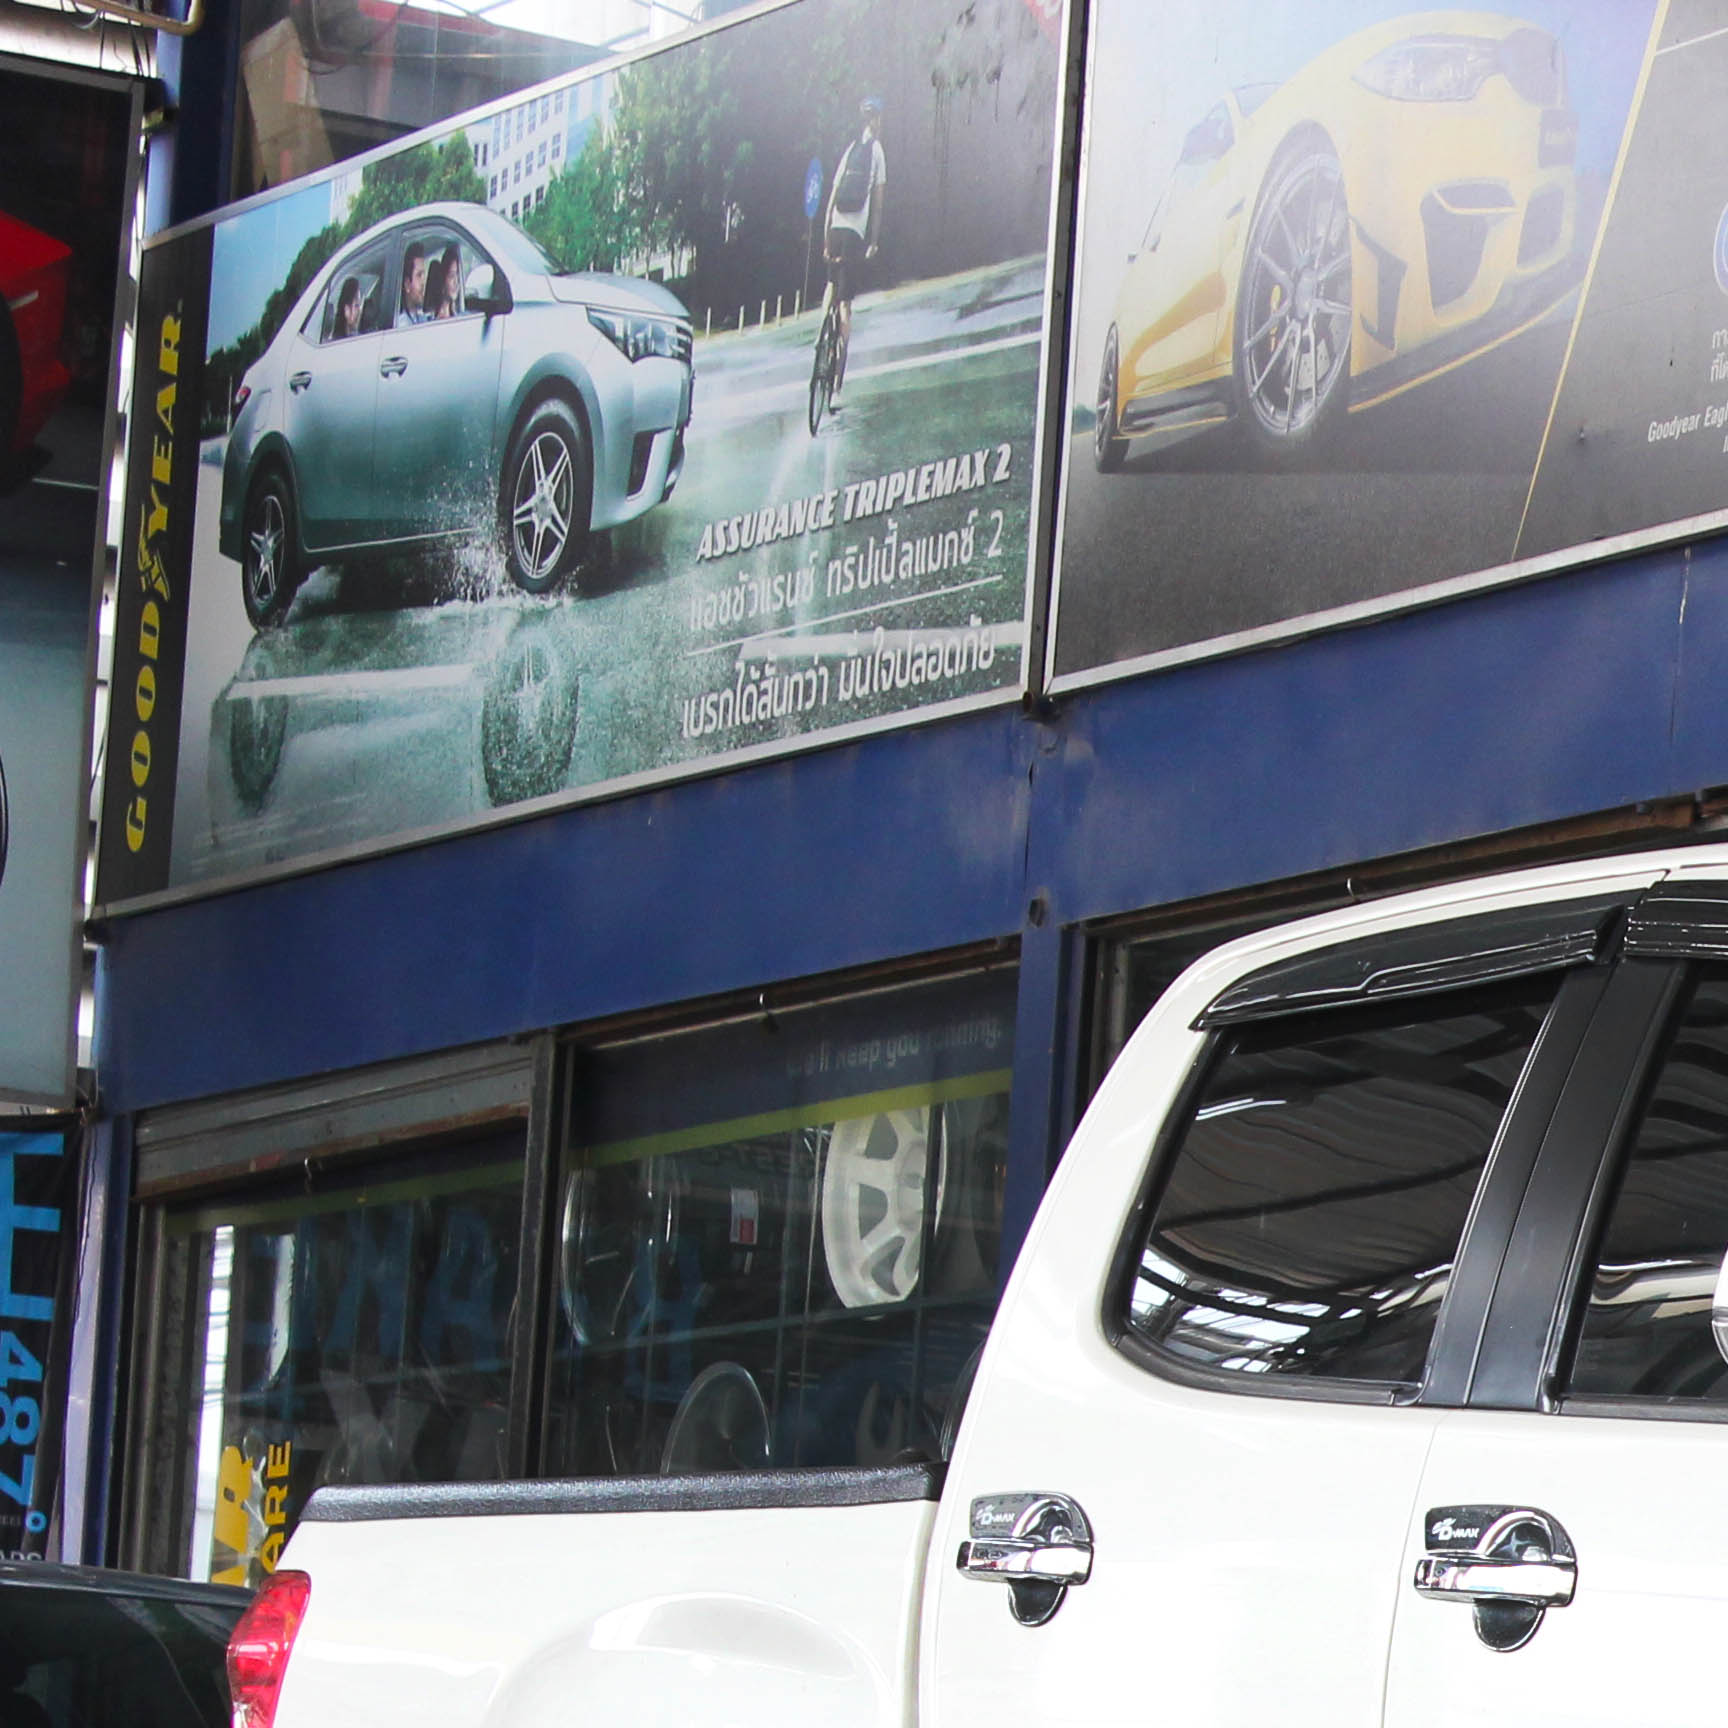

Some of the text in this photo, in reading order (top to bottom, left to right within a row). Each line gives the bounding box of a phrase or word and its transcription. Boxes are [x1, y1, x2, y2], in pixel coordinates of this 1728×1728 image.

[1648, 412, 1700, 443] Goodyear
[697, 443, 1012, 562] ASSURANCE TRIPLEMAX 2
[988, 509, 1005, 558] 2
[126, 304, 183, 853] GOODYEAR
